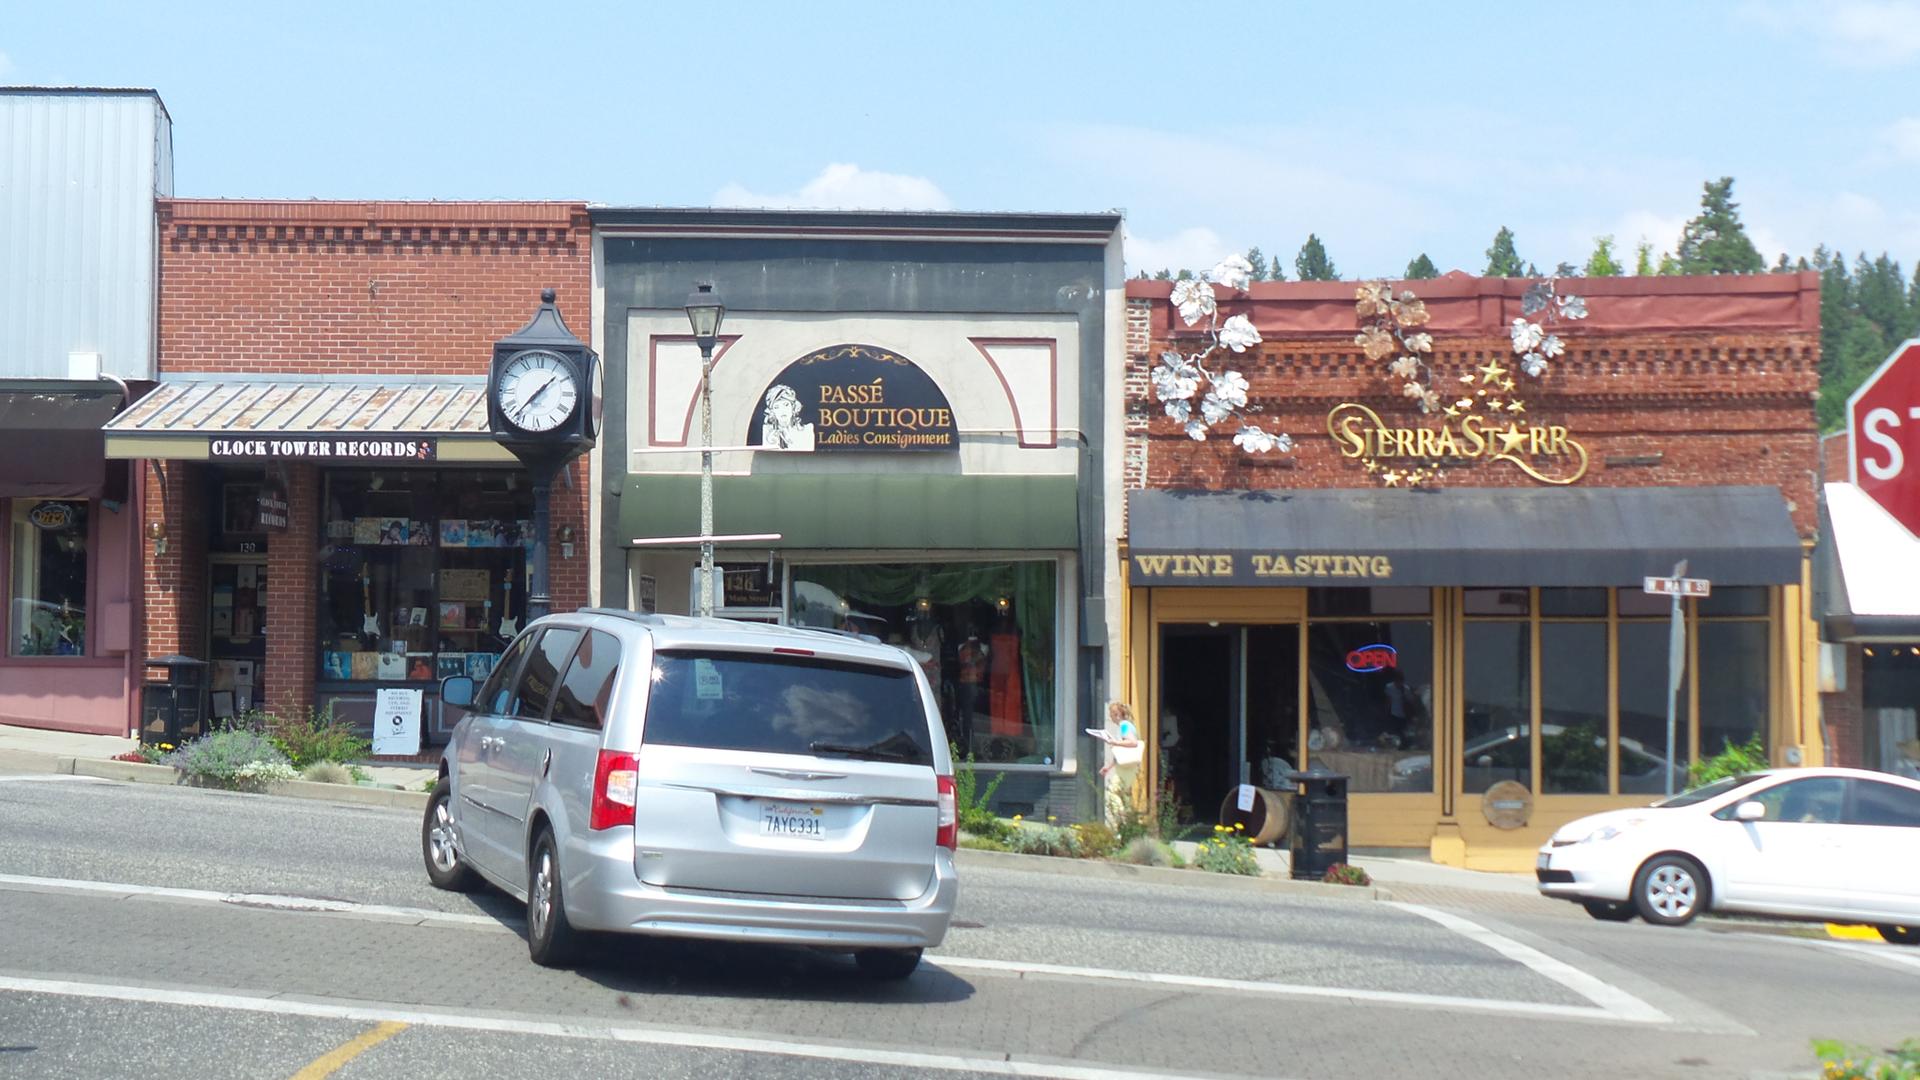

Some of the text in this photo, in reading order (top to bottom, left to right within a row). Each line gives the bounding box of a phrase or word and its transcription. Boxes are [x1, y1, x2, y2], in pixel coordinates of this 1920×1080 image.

[819, 377, 884, 404] PASSÉ
[818, 408, 951, 431] BOUTIQUE
[211, 440, 417, 457] CLOCK TOWER RECORDS
[818, 430, 951, 449] Ladies Consignment
[240, 542, 256, 553] 130
[1134, 554, 1393, 578] WINE TASTING
[1346, 650, 1397, 668] OPEN
[765, 815, 820, 835] 7AYC331
